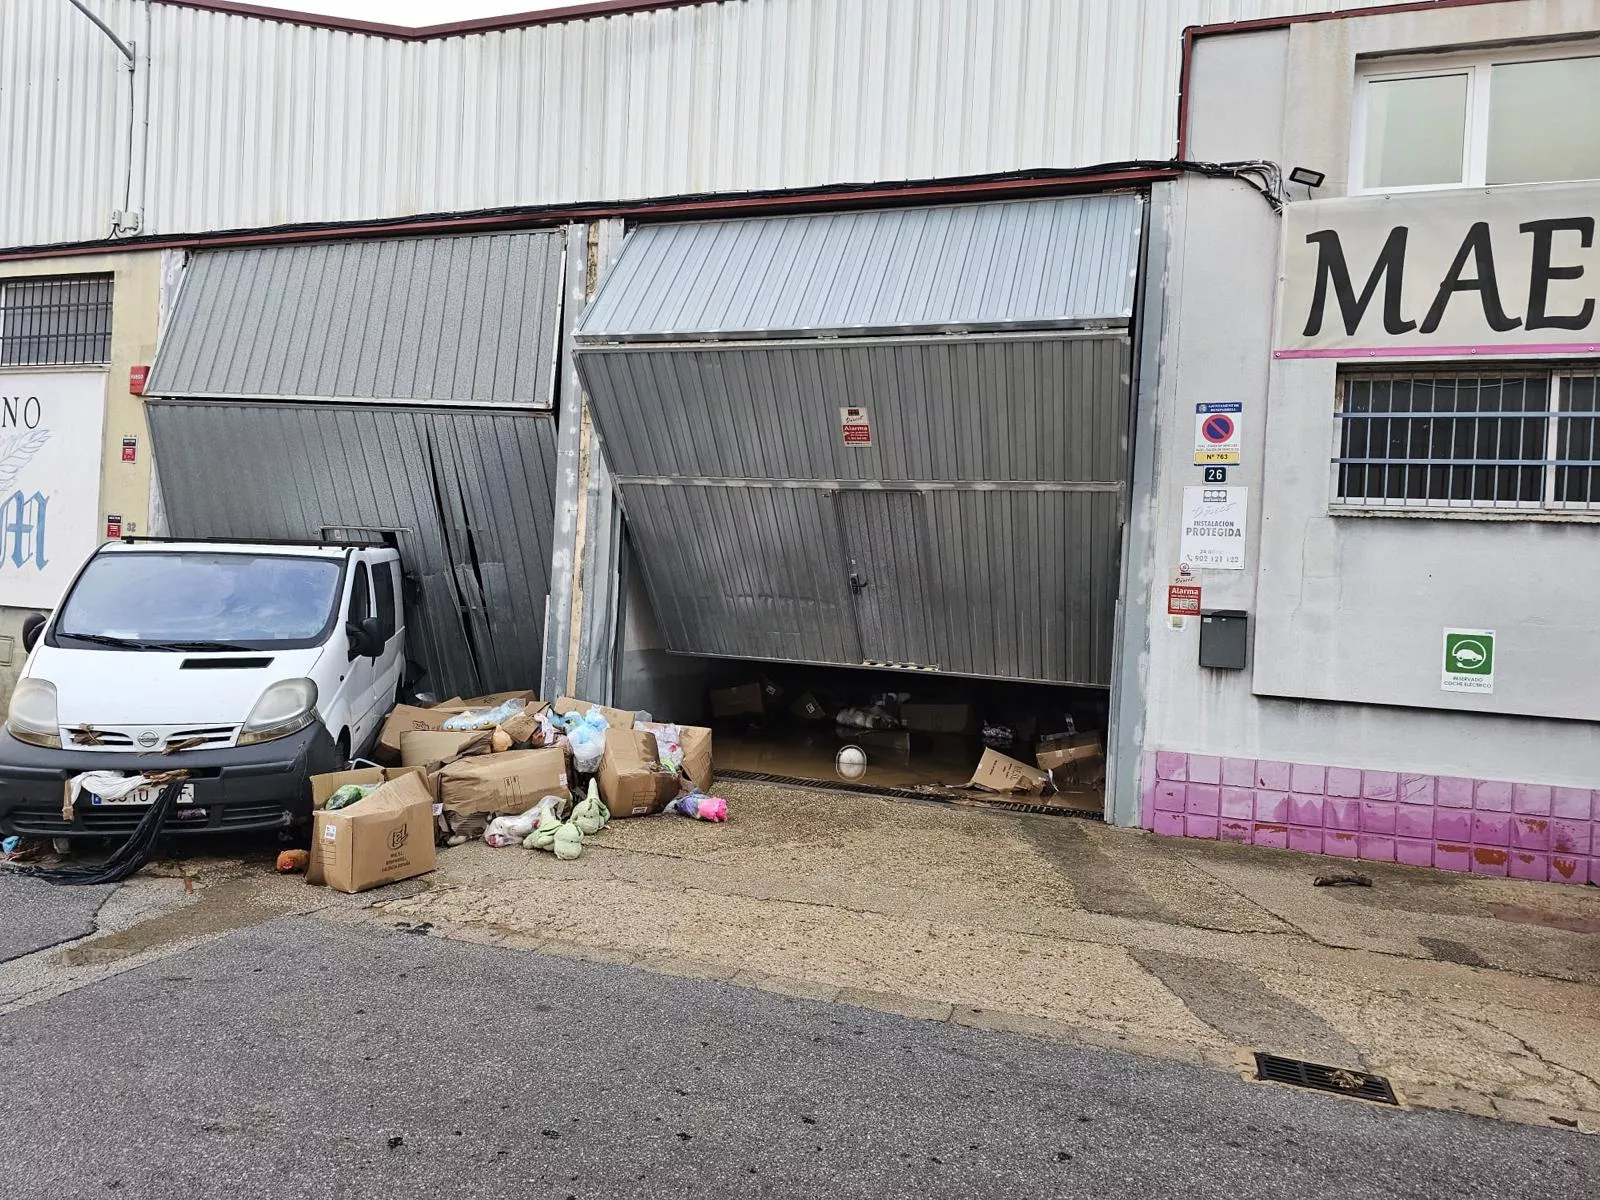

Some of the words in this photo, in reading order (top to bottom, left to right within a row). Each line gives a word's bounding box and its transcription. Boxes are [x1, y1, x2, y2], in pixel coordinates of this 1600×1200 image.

[1302, 216, 1595, 337] MAE
[1208, 469, 1223, 480] 26
[127, 522, 136, 532] 32
[1186, 527, 1241, 537] PROTEGIDA
[1171, 587, 1198, 595] Alarma
